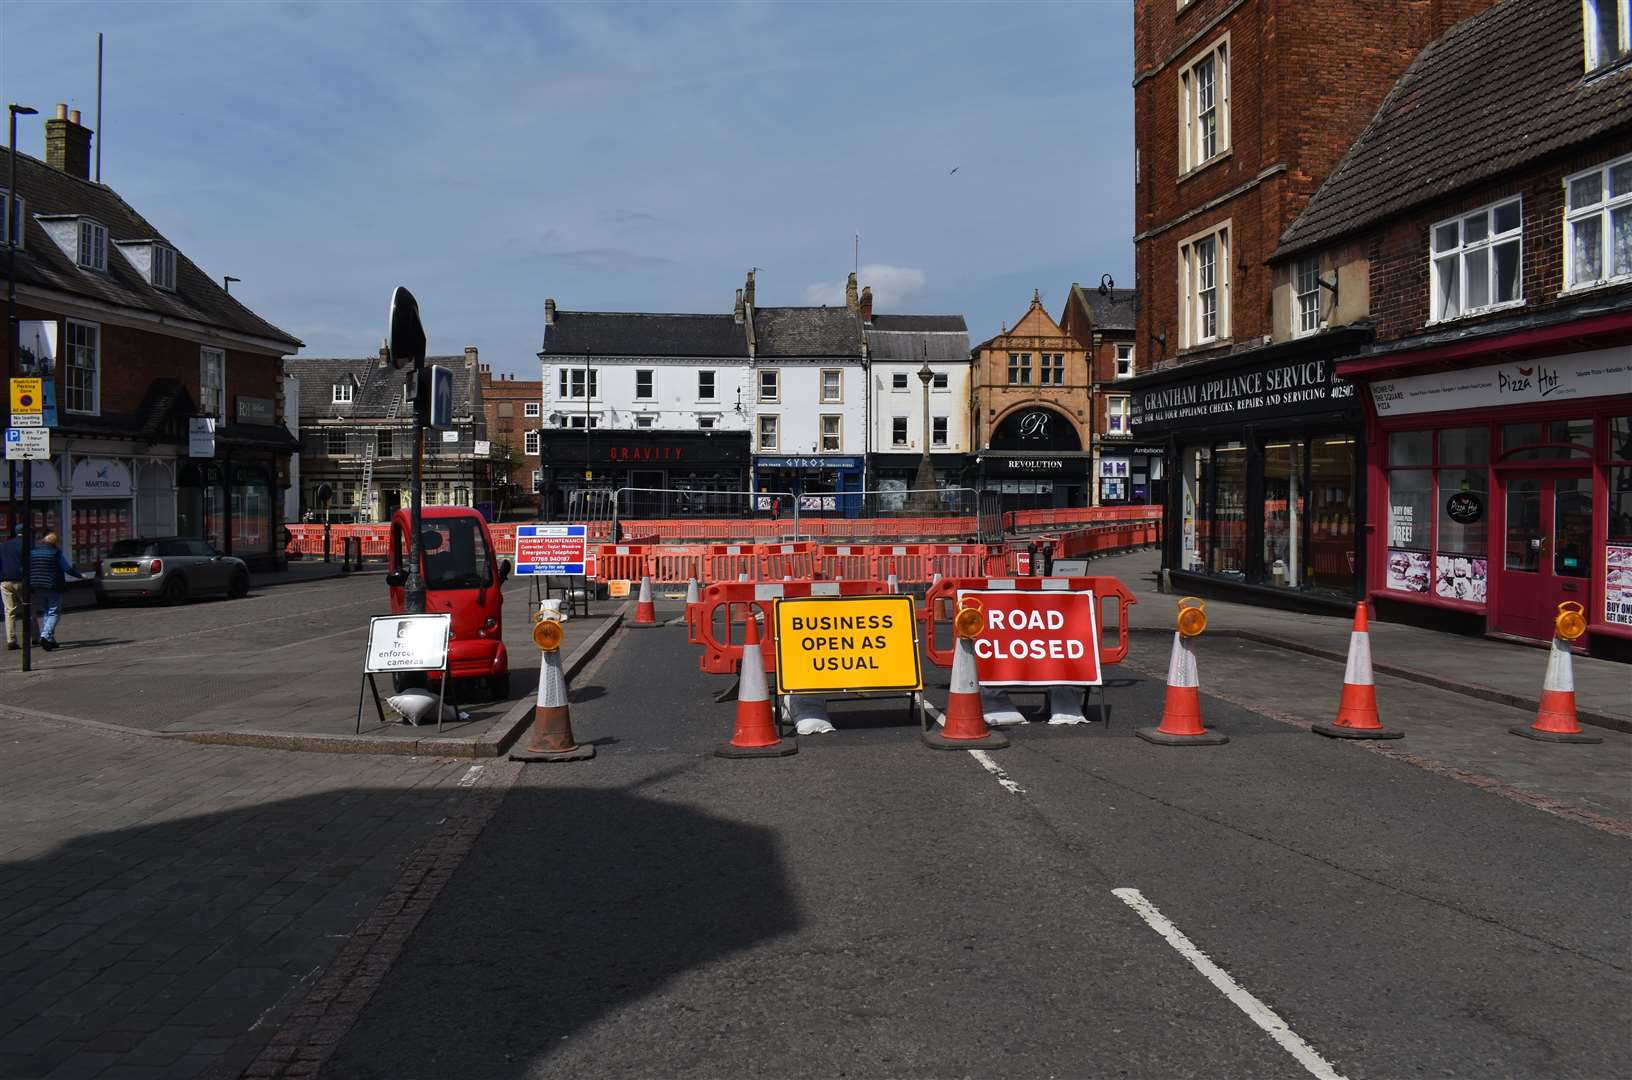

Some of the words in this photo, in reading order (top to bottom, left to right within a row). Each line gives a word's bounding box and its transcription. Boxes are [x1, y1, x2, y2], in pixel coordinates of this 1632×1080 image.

[1144, 384, 1197, 411] GRANTHAM
[1200, 372, 1263, 402] APPLIANCE
[1266, 360, 1326, 391] SERVICE
[1498, 369, 1532, 393] Pizza
[1538, 364, 1560, 393] Hot
[1155, 411, 1164, 421] ALL
[1165, 409, 1178, 419] YOUR
[1179, 405, 1208, 418] APPLIANCE
[1209, 401, 1235, 414] CHECKS,
[1237, 396, 1264, 410] REPAIRS
[1266, 394, 1281, 406] AND
[1283, 387, 1326, 404] SERVICING
[1020, 411, 1052, 437] R
[10, 430, 19, 441] P
[786, 458, 825, 468] GYROS
[1008, 460, 1063, 469] REVOLUTION
[1393, 526, 1413, 542] FREE!
[1607, 602, 1620, 612] BUY
[792, 615, 894, 631] BUSINESS
[988, 609, 1065, 631] ROAD
[1607, 612, 1616, 621] GET
[1617, 614, 1627, 623] ONE
[801, 636, 854, 651] OPEN
[862, 635, 887, 649] AS
[974, 639, 1084, 660] CLOSED
[813, 656, 879, 671] USUAL
